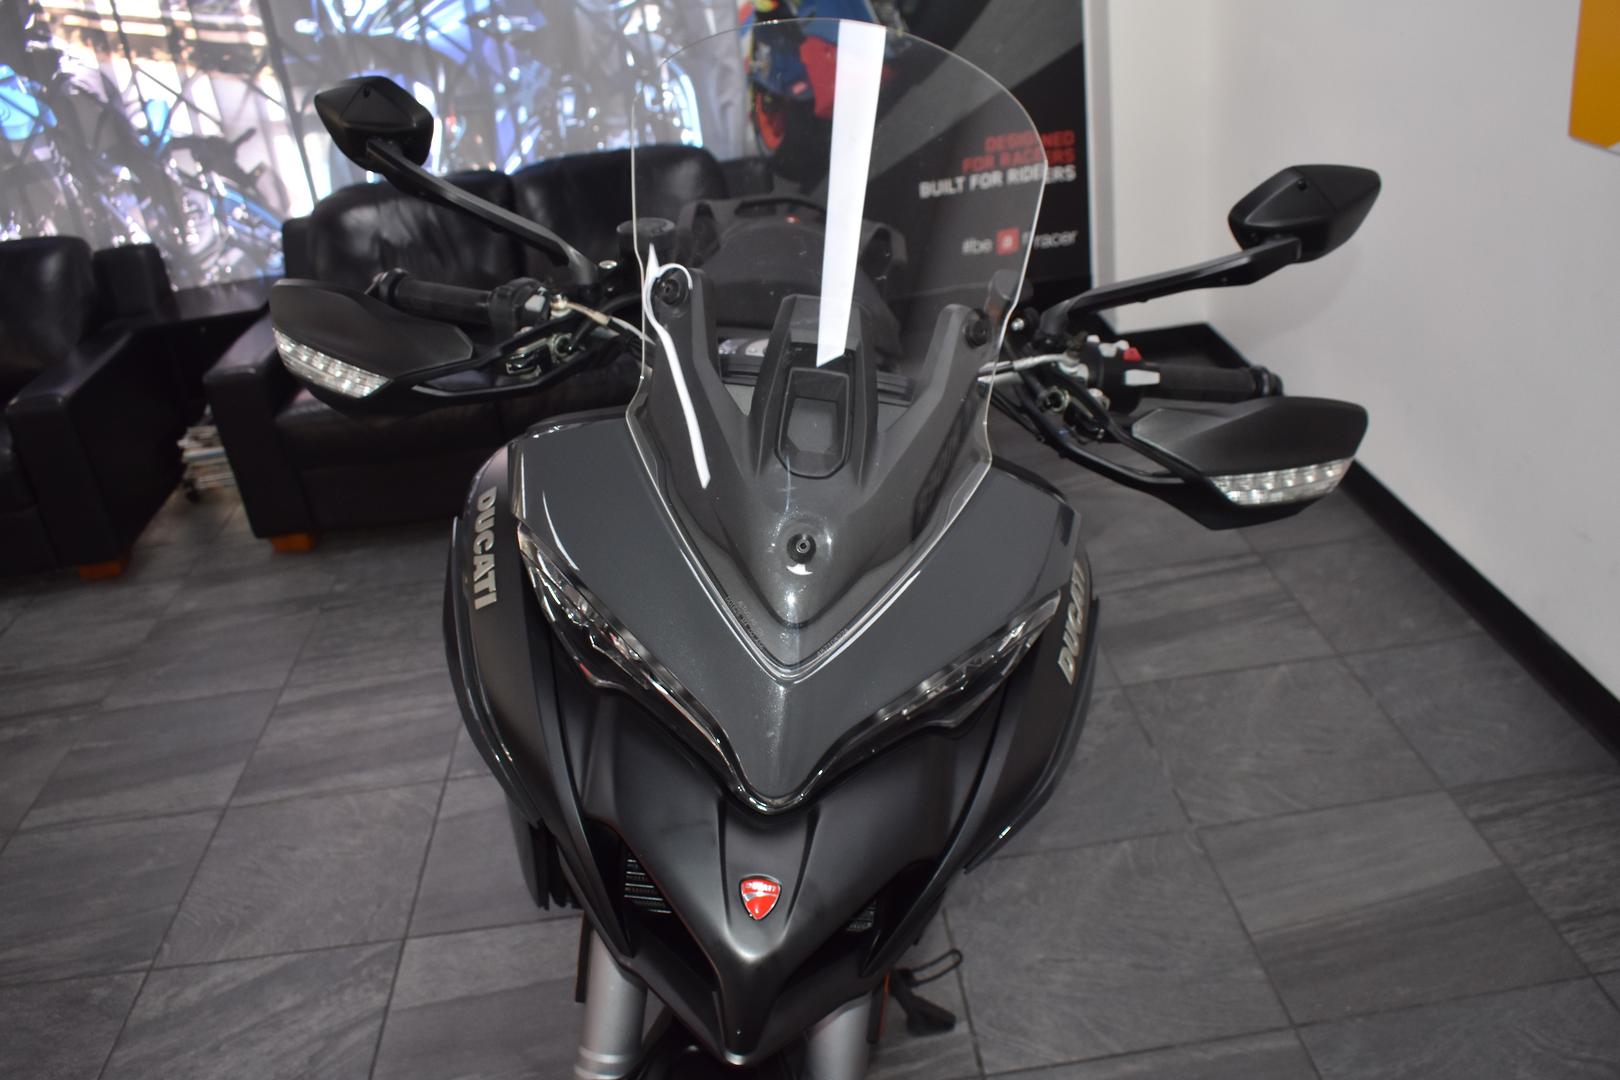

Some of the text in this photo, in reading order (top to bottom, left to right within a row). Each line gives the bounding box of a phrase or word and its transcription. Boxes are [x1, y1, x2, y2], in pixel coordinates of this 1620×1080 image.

[962, 155, 995, 173] FOR
[919, 176, 964, 198] BUILT
[969, 170, 1003, 190] FOR
[473, 486, 497, 610] DUCATI
